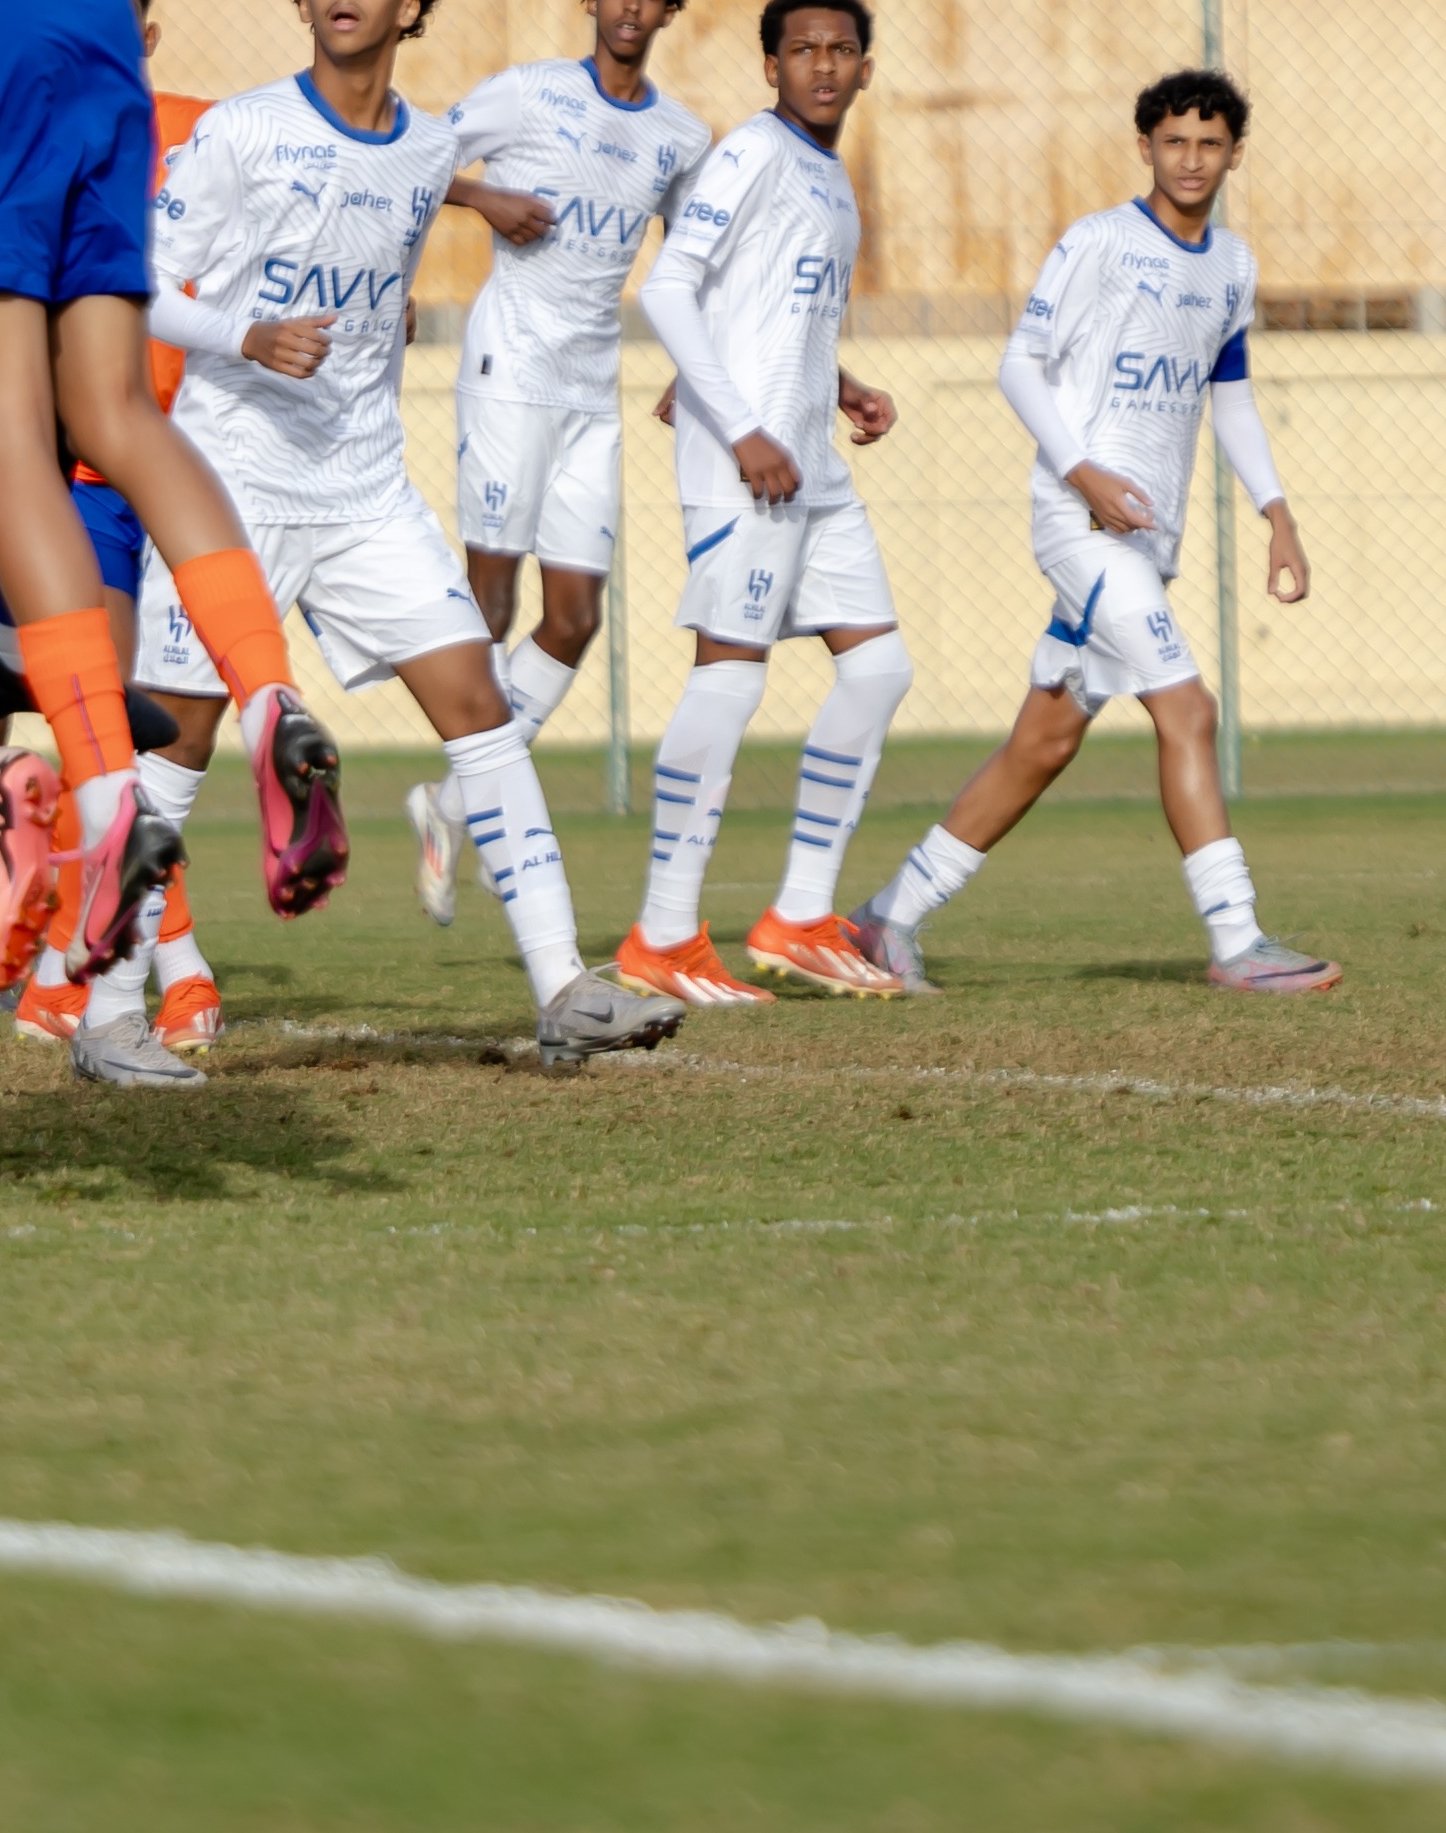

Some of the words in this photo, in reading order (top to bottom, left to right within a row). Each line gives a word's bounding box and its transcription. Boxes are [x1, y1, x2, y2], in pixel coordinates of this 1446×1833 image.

[275, 144, 338, 164] flynas
[258, 256, 406, 310] SAVV
[1114, 351, 1211, 396] SAVV
